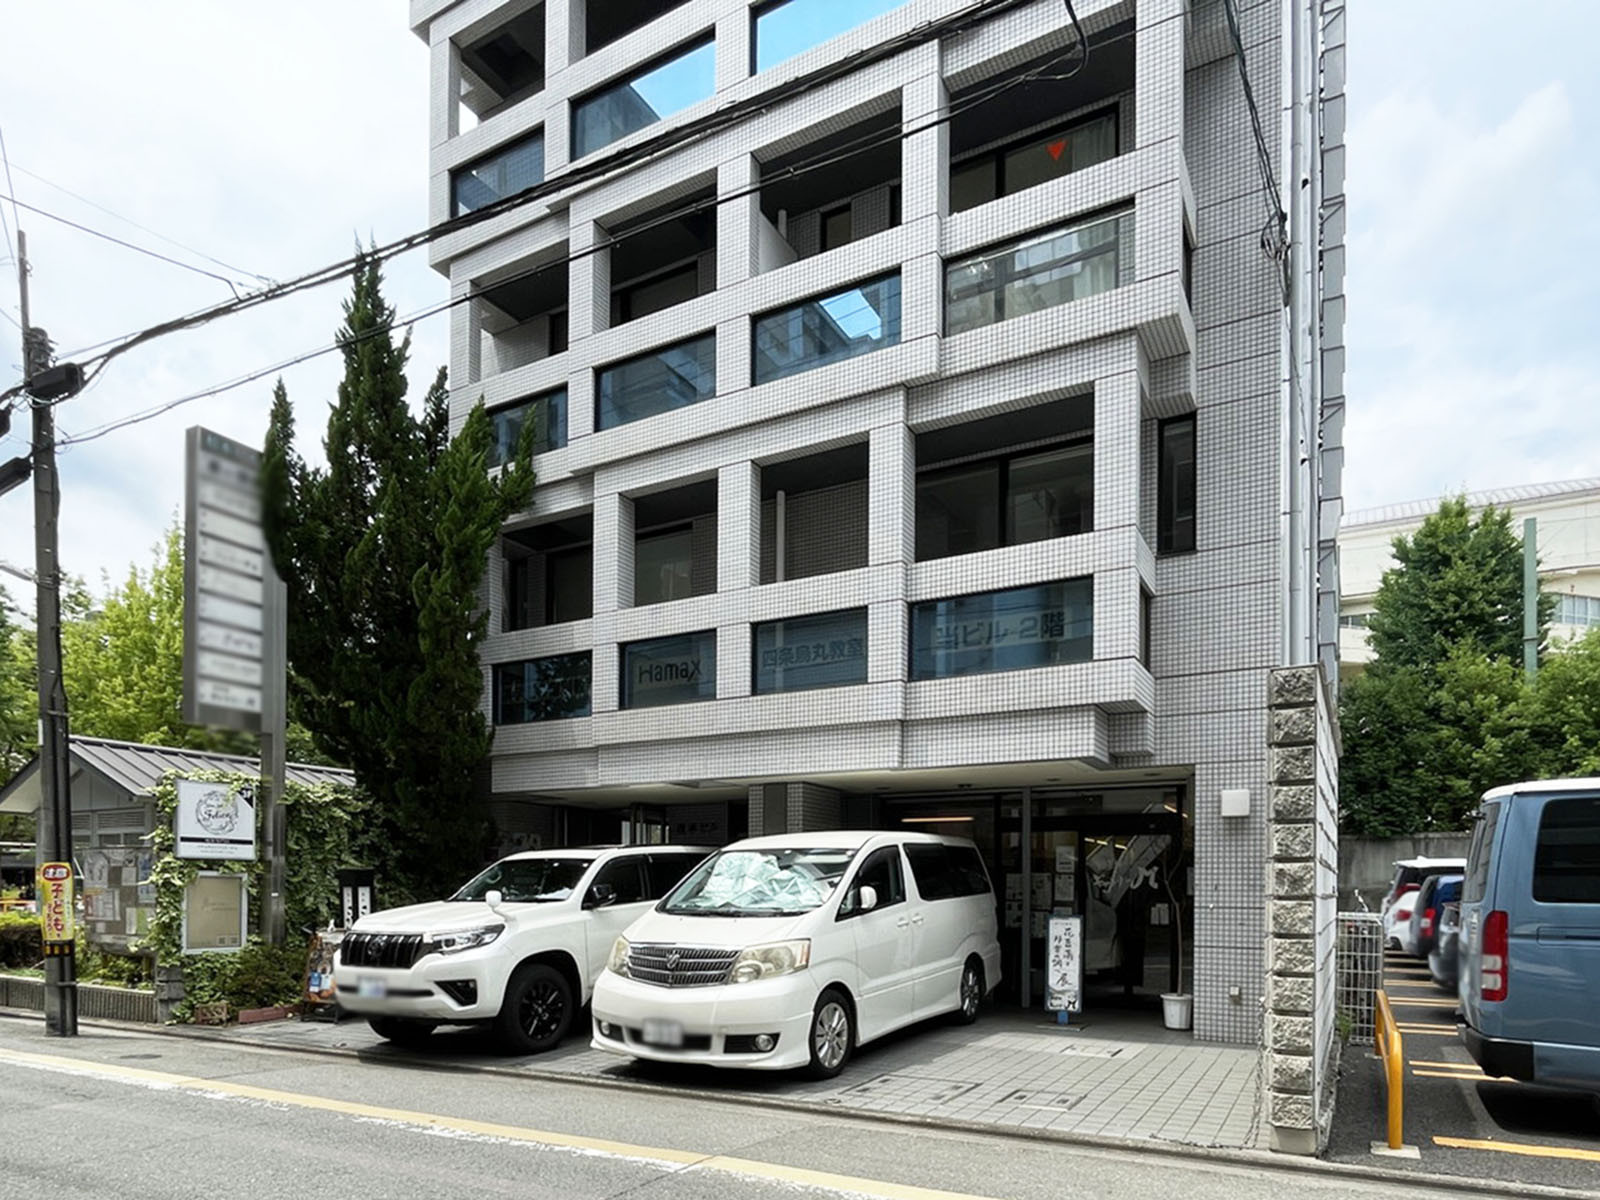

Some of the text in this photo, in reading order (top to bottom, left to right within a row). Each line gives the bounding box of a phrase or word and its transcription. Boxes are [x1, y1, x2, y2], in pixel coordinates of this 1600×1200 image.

[762, 638, 865, 668] 四条烏丸教室
[638, 660, 702, 684] Hamax
